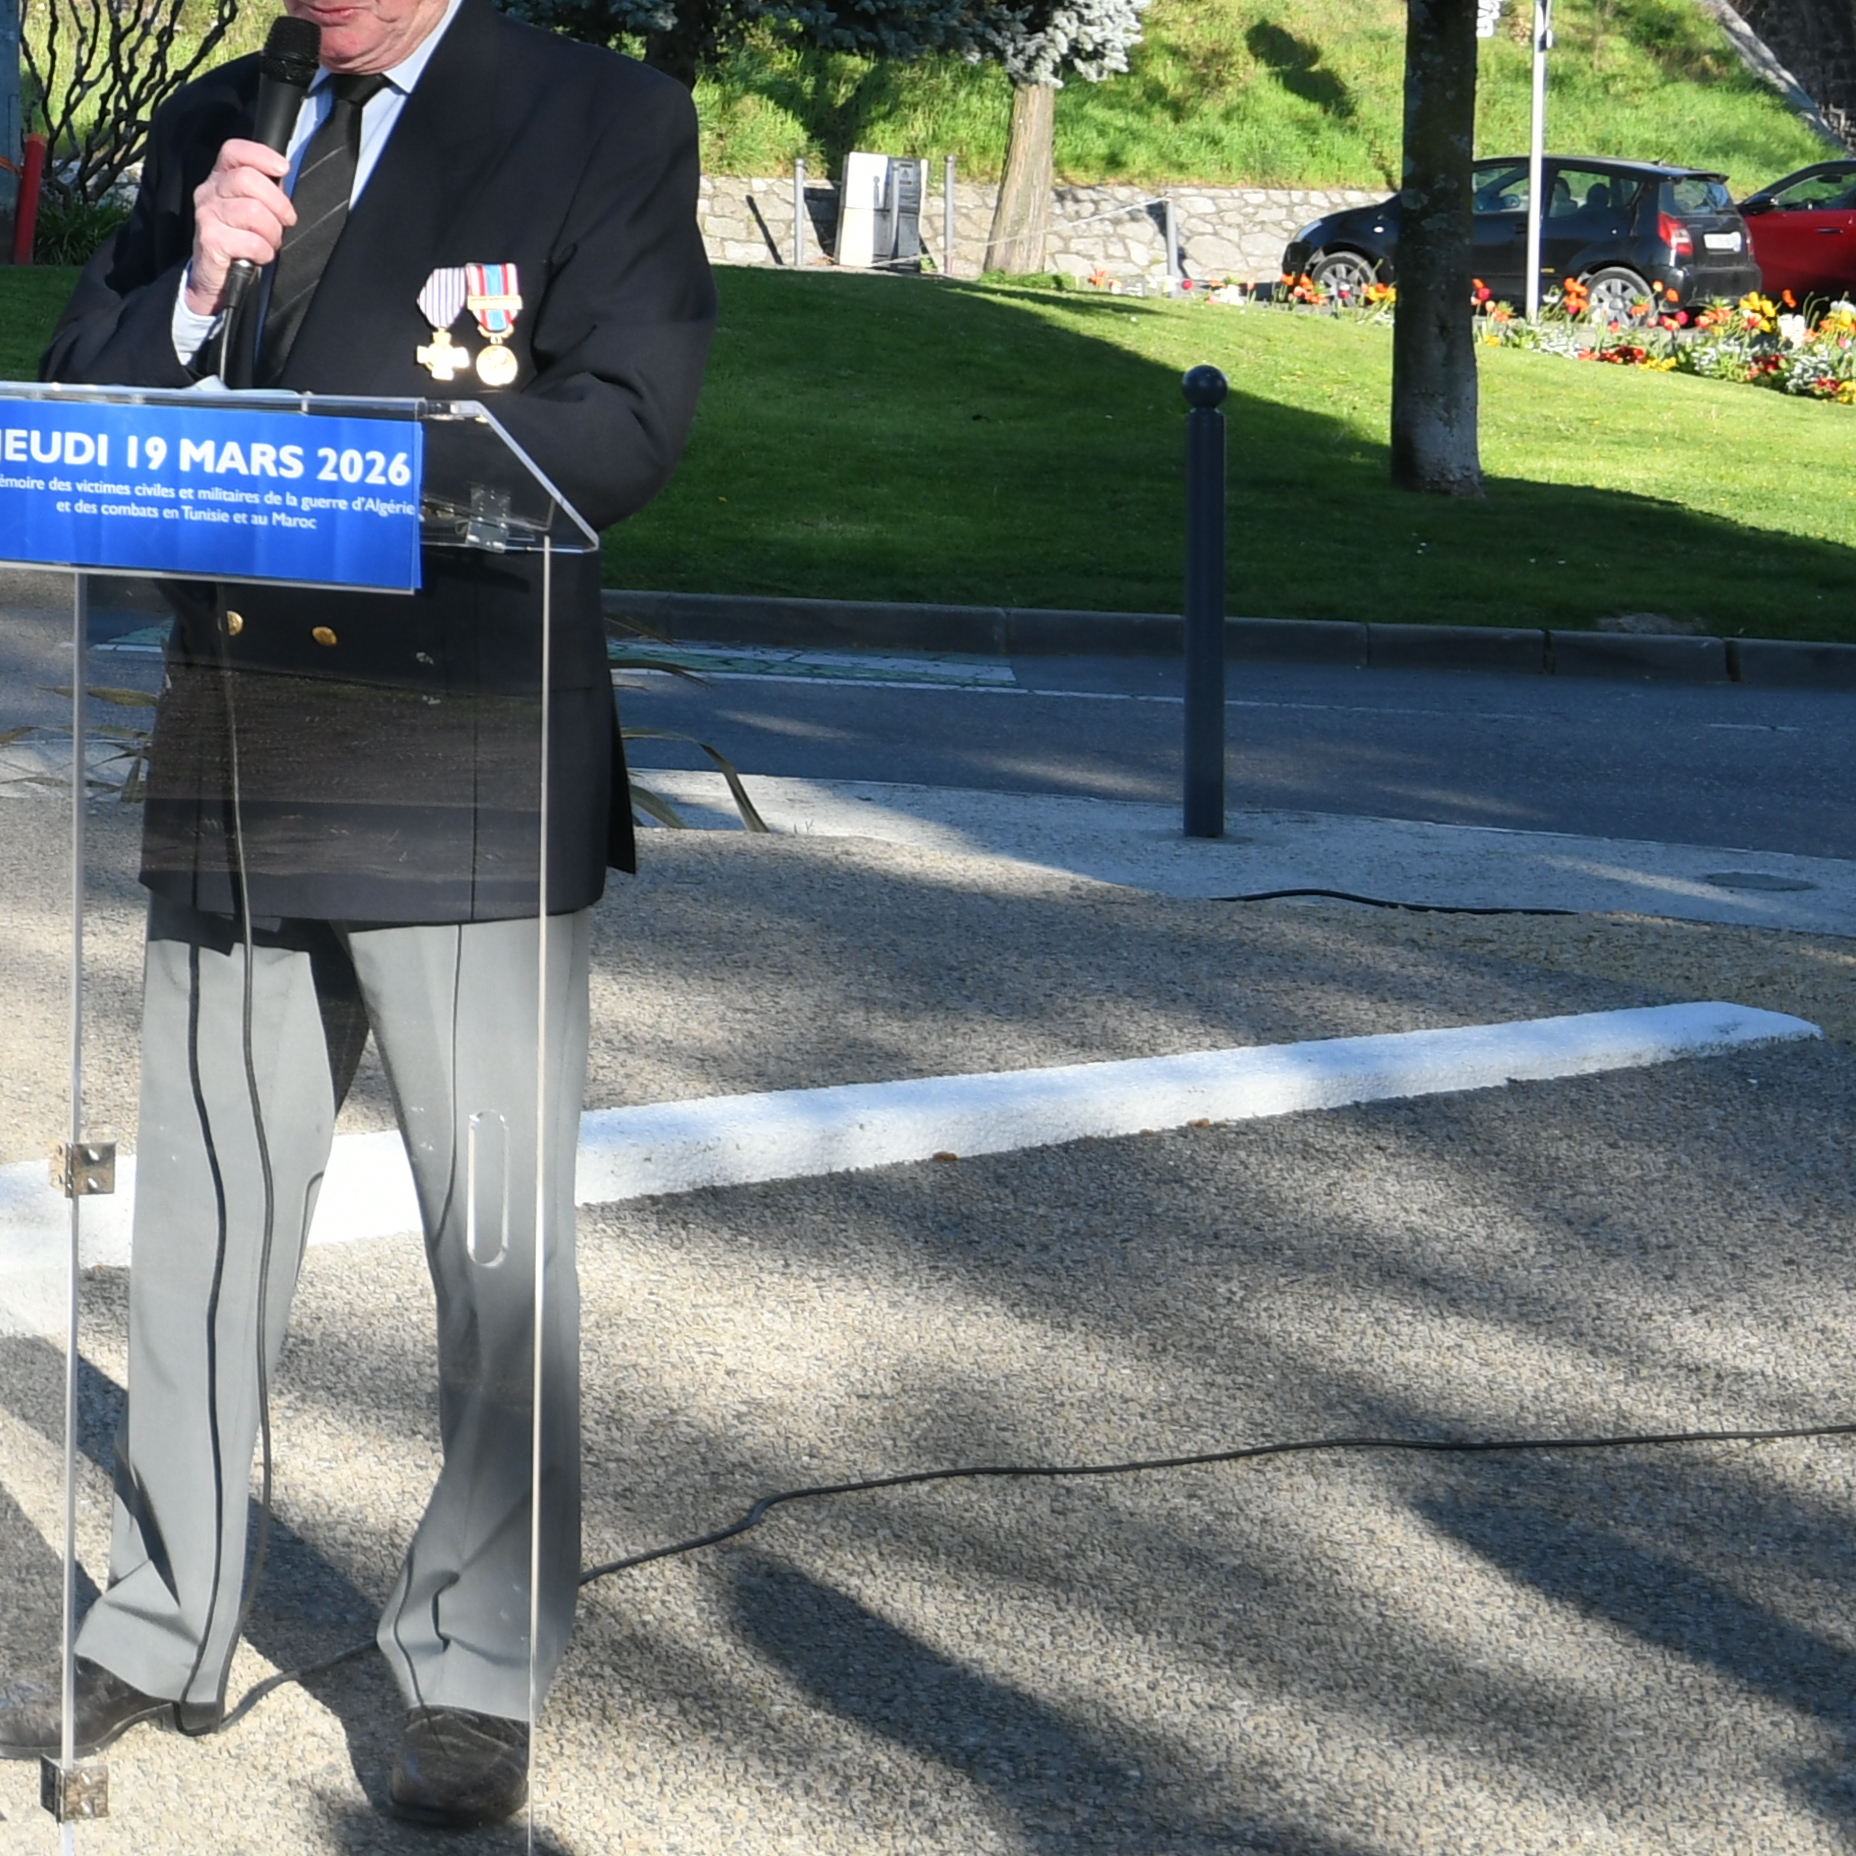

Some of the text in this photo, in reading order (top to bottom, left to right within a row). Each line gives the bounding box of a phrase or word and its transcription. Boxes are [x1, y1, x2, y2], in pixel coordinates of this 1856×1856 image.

[126, 435, 167, 470] 19
[179, 438, 304, 478] MARS
[316, 447, 411, 486] 2026
[48, 477, 72, 492] des
[76, 479, 130, 495] victimes
[134, 481, 175, 498] civiles
[178, 487, 194, 500] et
[198, 487, 260, 504] militaires
[264, 490, 282, 505] de
[286, 492, 298, 507] la
[302, 498, 347, 511] guerre
[56, 499, 316, 528] et des combats en Tunisie et au Maroc
